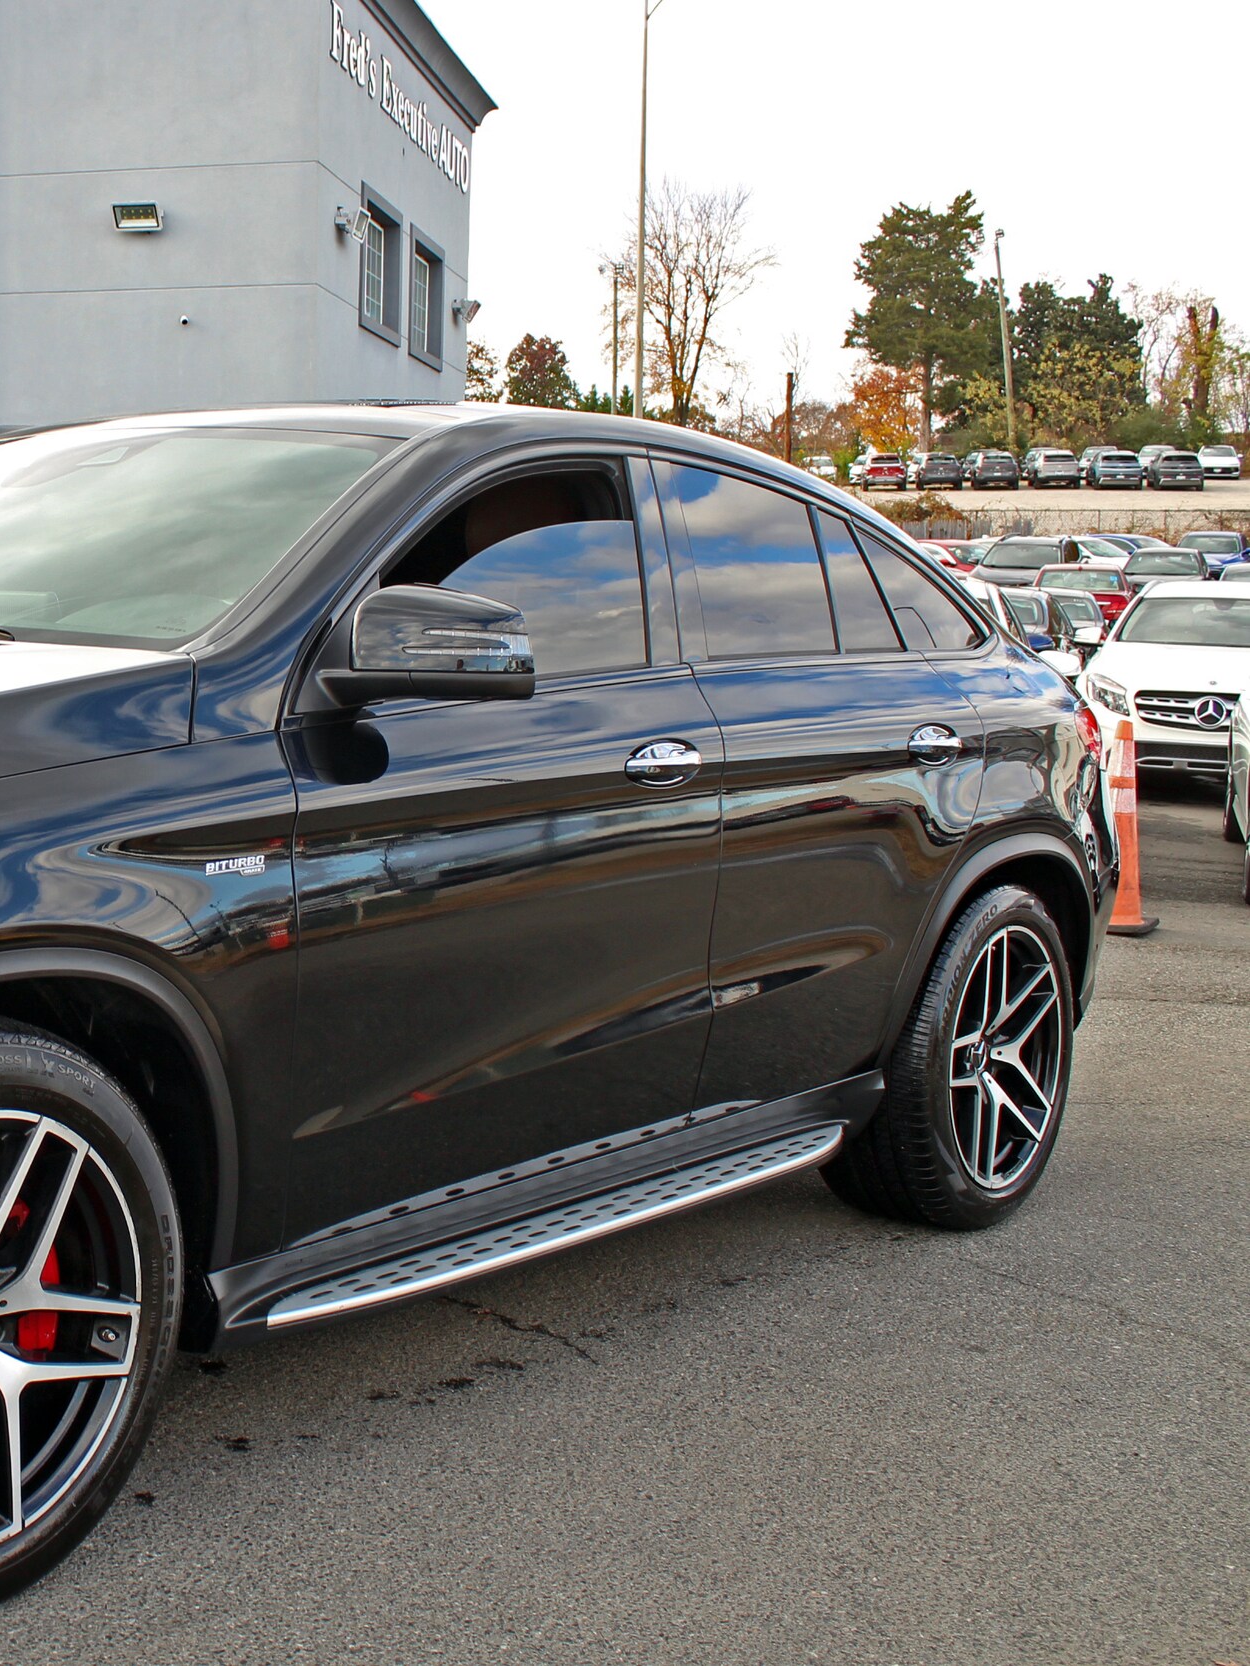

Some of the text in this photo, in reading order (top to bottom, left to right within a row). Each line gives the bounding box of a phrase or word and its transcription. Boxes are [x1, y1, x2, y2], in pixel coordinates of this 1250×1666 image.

[330, 0, 469, 194] Fred's Executive AUTO
[205, 855, 265, 873] BITURBO
[57, 1064, 96, 1090] SPORT
